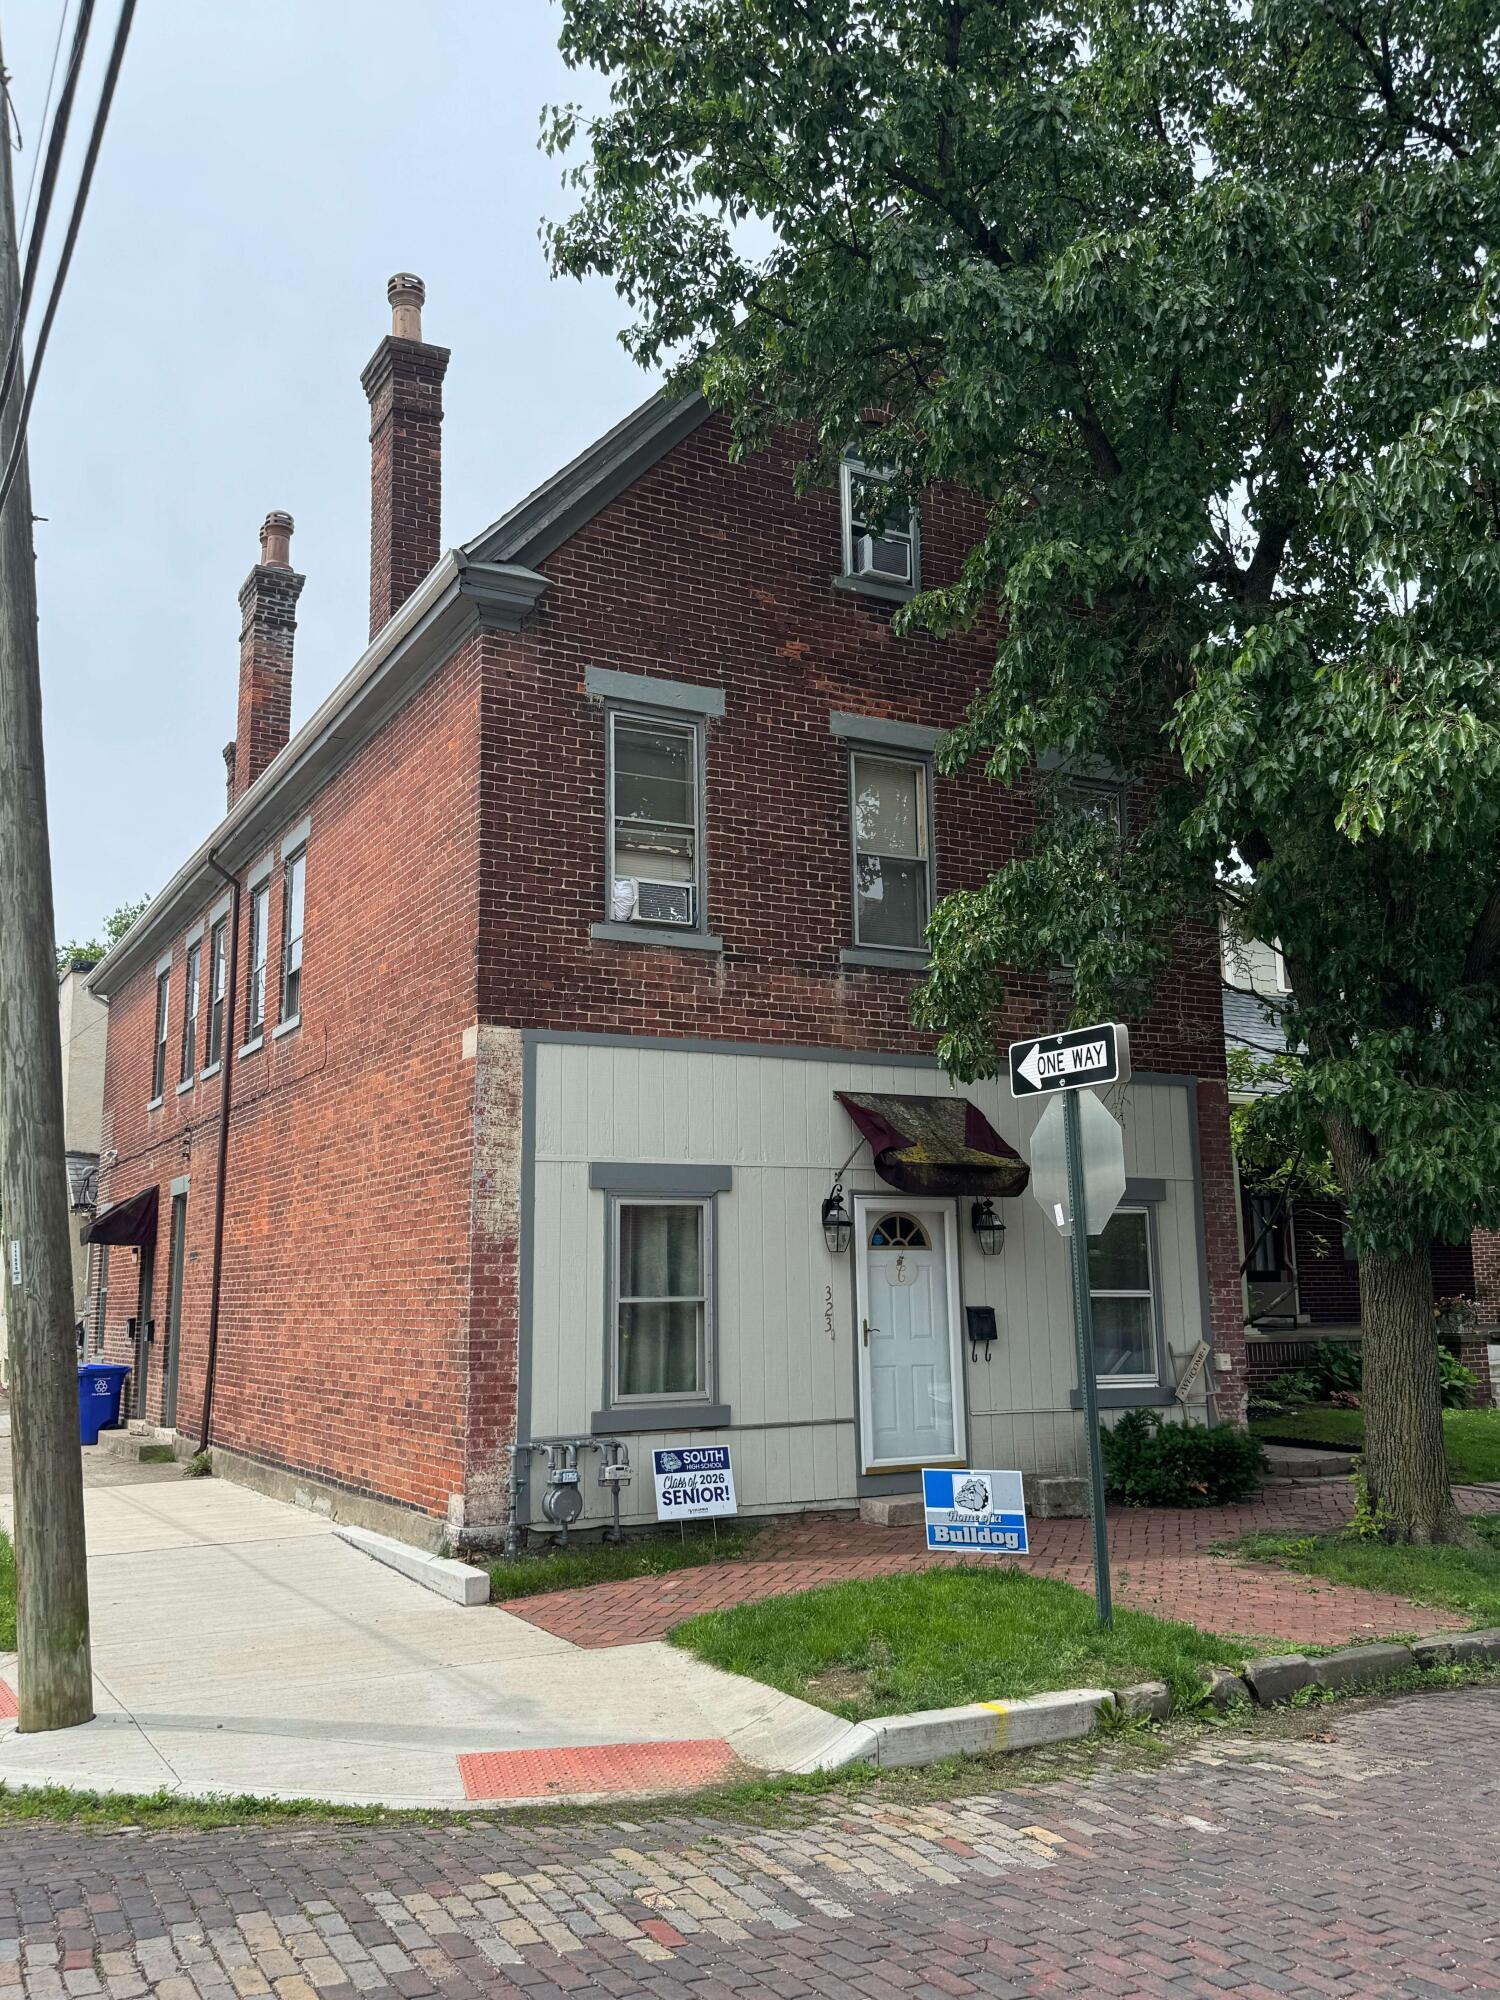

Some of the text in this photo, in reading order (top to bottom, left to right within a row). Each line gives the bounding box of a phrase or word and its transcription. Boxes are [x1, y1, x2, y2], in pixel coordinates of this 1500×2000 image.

[1037, 1044, 1104, 1076] ONE WAY
[683, 1450, 724, 1463] SOUTH
[664, 1473, 725, 1490] Class of 2026
[662, 1486, 730, 1506] SENIOR!
[947, 1510, 981, 1523] Home
[980, 1512, 992, 1525] of
[934, 1526, 1019, 1550] Bulldog
